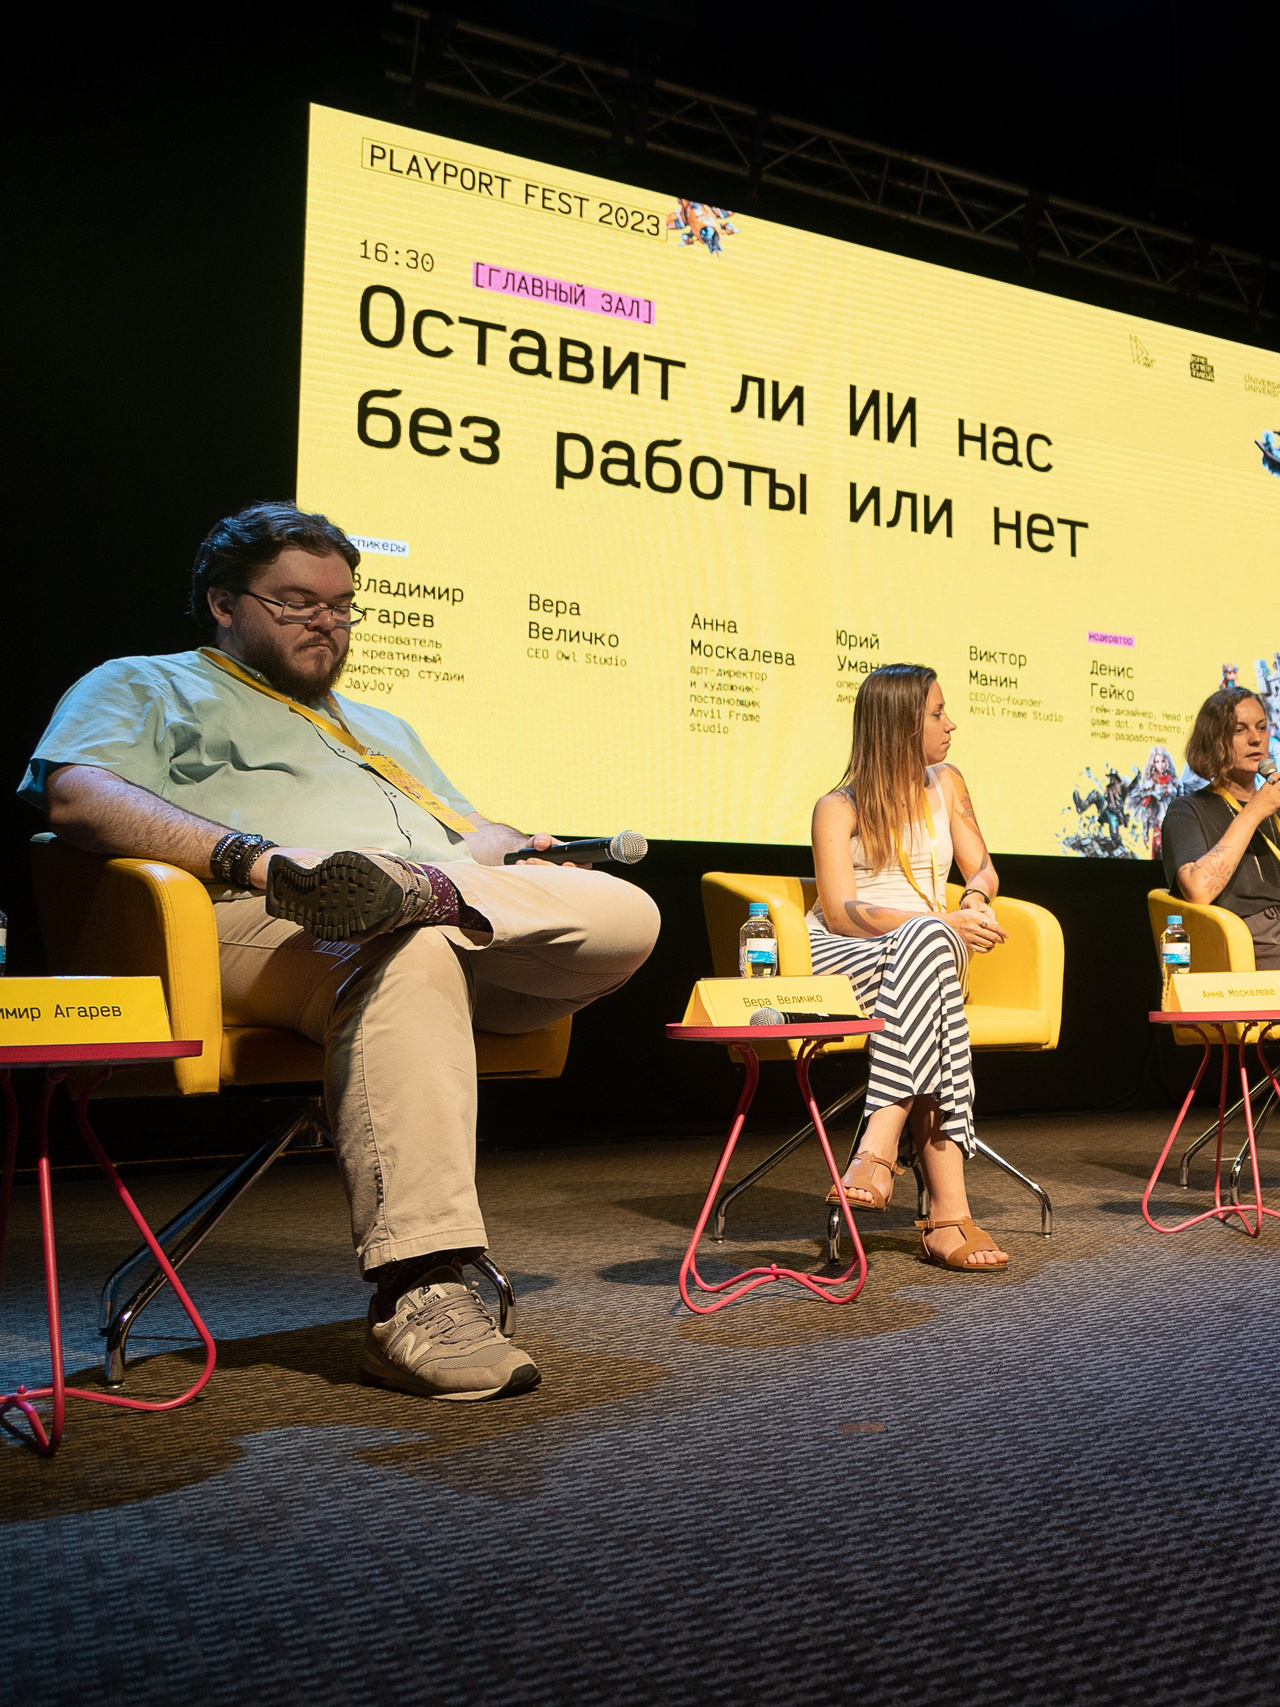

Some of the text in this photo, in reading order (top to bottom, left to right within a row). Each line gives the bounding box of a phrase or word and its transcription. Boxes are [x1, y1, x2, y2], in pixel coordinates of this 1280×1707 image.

[369, 144, 661, 237] PLAYPORT FEST 2023
[359, 239, 434, 273] 16:30
[474, 262, 653, 325] [ГЛАВНЫЙ ЗАЛ]
[359, 284, 1054, 473] Оставит ли ИИ нас
[356, 388, 1090, 558] без работы или нет
[350, 537, 407, 554] спикеры
[353, 572, 464, 606] Владимир
[529, 593, 581, 617] Вера
[352, 602, 435, 628] гарев
[690, 612, 738, 634] Анна
[349, 632, 443, 649] сооснователь
[528, 621, 619, 648] Величко
[836, 629, 880, 650] Юрий
[1088, 632, 1133, 646] модератор
[362, 649, 442, 664] креативный
[527, 647, 549, 660] CEO
[585, 653, 627, 667] Studio
[690, 638, 796, 666] Москалева
[969, 645, 1027, 669] Виктор
[345, 663, 465, 682] директор студии
[690, 665, 768, 682] арт-директор
[837, 655, 888, 674] Уман
[1090, 660, 1134, 679] Денис
[345, 677, 394, 693] JayJoy
[969, 669, 1018, 689] Манин
[690, 694, 760, 708] постановщик
[1090, 682, 1135, 701] Гейко
[689, 707, 722, 720] Anvil
[969, 705, 1064, 723] Anvil Frame Studio
[690, 722, 729, 735] studio
[742, 993, 823, 1008] Вера Величко
[1202, 988, 1276, 999] Анна Москалева
[54, 1004, 122, 1020] Агарев
